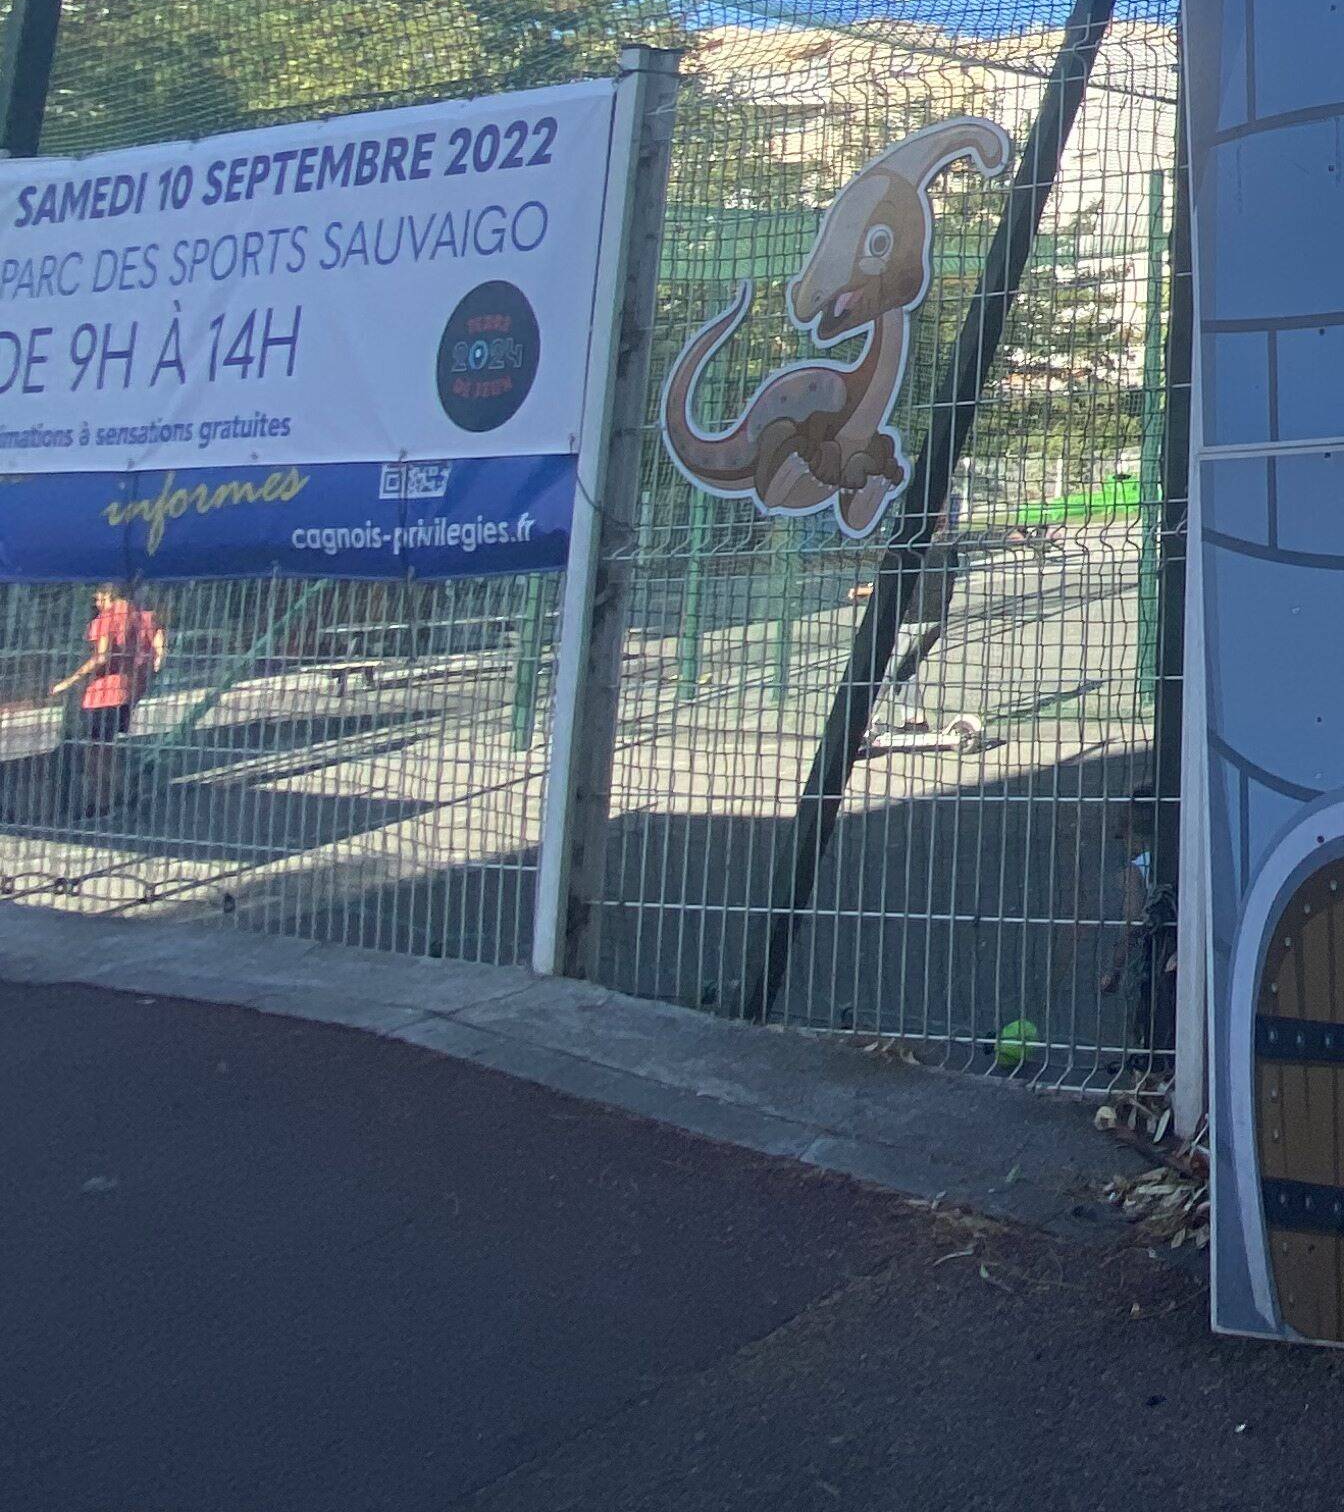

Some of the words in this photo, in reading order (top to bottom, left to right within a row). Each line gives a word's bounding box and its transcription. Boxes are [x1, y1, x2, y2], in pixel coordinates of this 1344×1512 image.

[14, 172, 149, 228] SAMEDI
[159, 164, 194, 211] 10
[202, 132, 437, 206] SEPTEMBRE
[444, 116, 559, 176] 2022
[0, 251, 84, 300] PARC
[92, 243, 160, 294] DES
[169, 225, 308, 287] SPORTS
[319, 200, 549, 270] SAUVAIGO
[70, 321, 138, 392] 9H
[149, 299, 187, 388] À
[208, 304, 302, 382] 14H
[96, 419, 193, 446] sensations
[198, 411, 292, 449] gratuites
[102, 467, 310, 557] informes
[291, 512, 536, 555] cagnois-privilegies.fr
